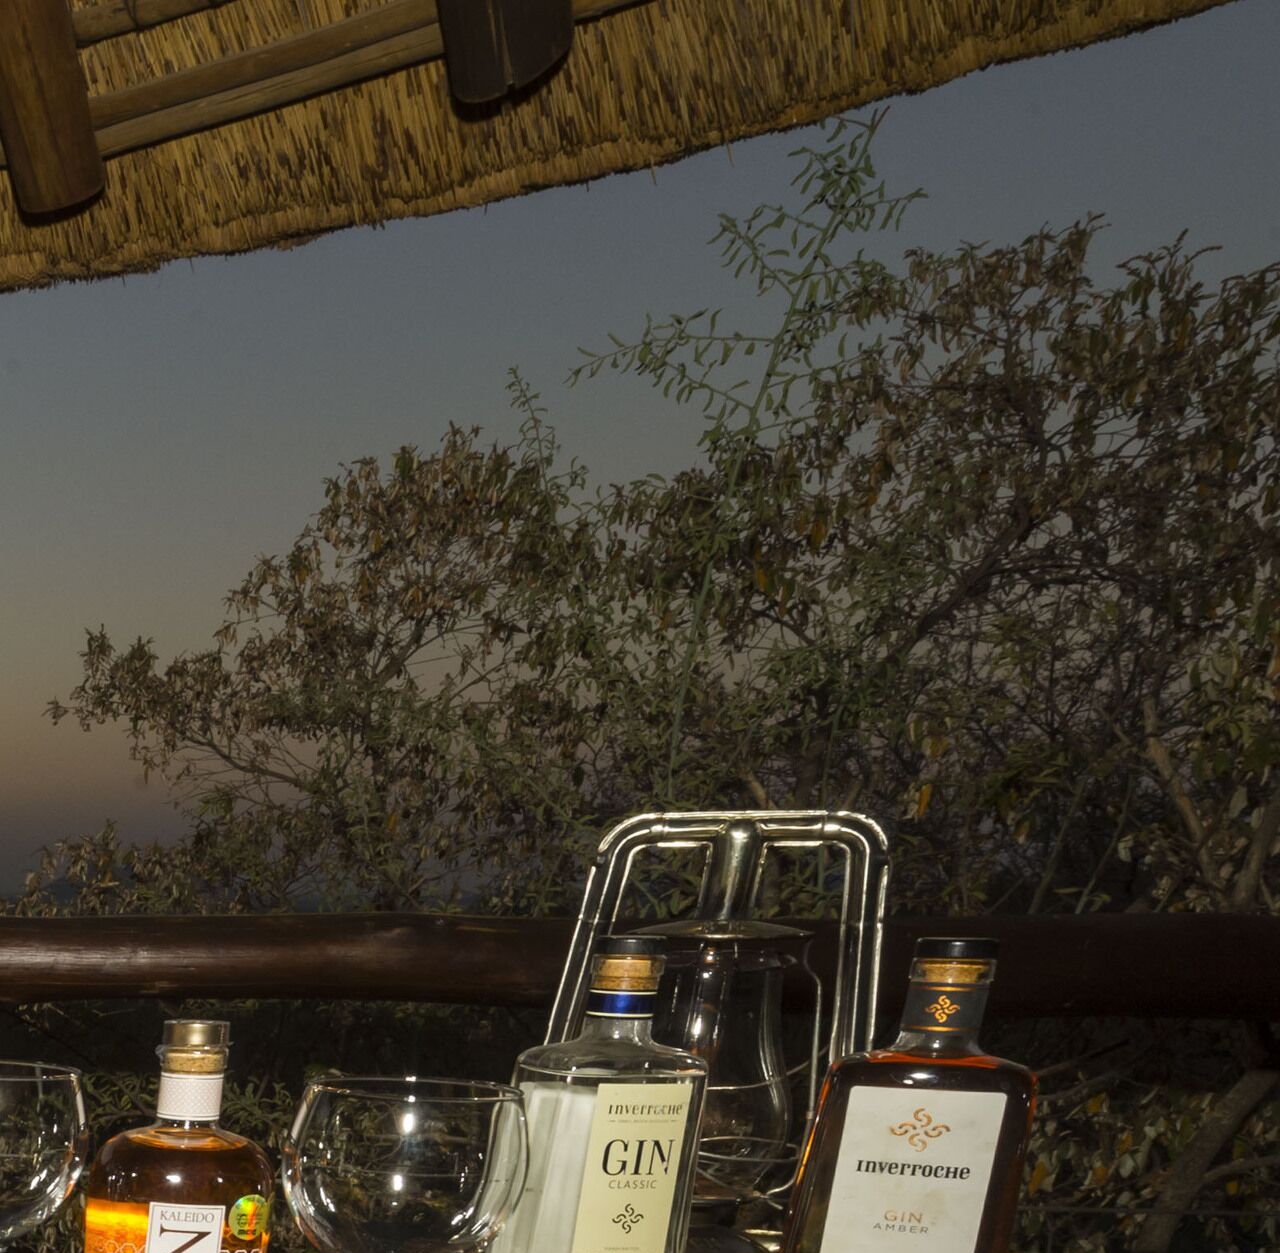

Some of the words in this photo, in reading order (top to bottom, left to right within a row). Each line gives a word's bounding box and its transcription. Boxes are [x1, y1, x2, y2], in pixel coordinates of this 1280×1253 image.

[602, 1138, 677, 1177] GIN
[608, 1180, 658, 1190] CLASSIC
[160, 1209, 216, 1224] KALEIDO
[884, 1209, 925, 1224] GIN
[872, 1222, 929, 1235] AMBER
